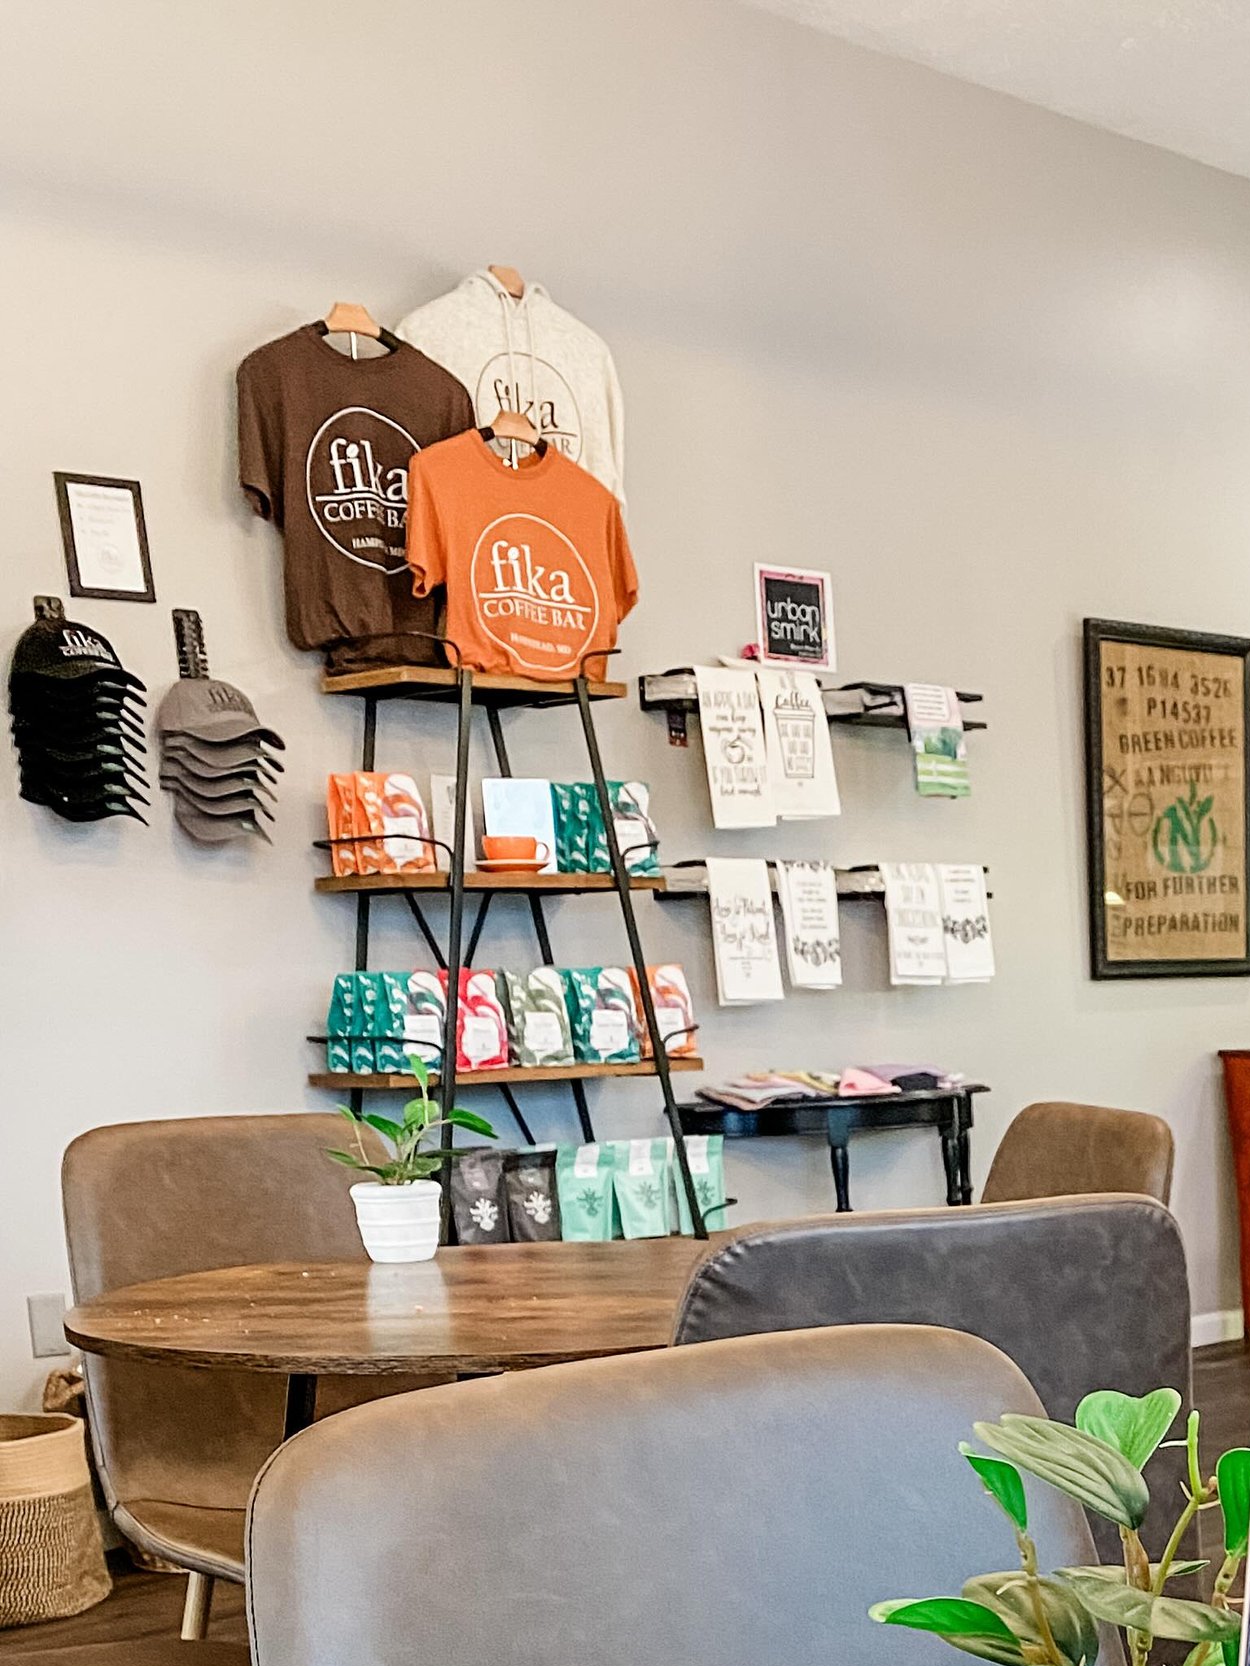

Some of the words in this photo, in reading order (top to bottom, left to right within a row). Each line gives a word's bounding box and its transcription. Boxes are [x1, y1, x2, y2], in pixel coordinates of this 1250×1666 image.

[329, 438, 407, 500] fika
[490, 540, 576, 604] fika
[483, 598, 549, 626] COFFEE
[766, 597, 820, 624] urban
[770, 619, 821, 643] smirk
[1177, 726, 1238, 750] COFFEE
[1126, 879, 1158, 902] FOR
[1163, 874, 1240, 898] FURTHER
[1122, 911, 1241, 937] PREPARATION
